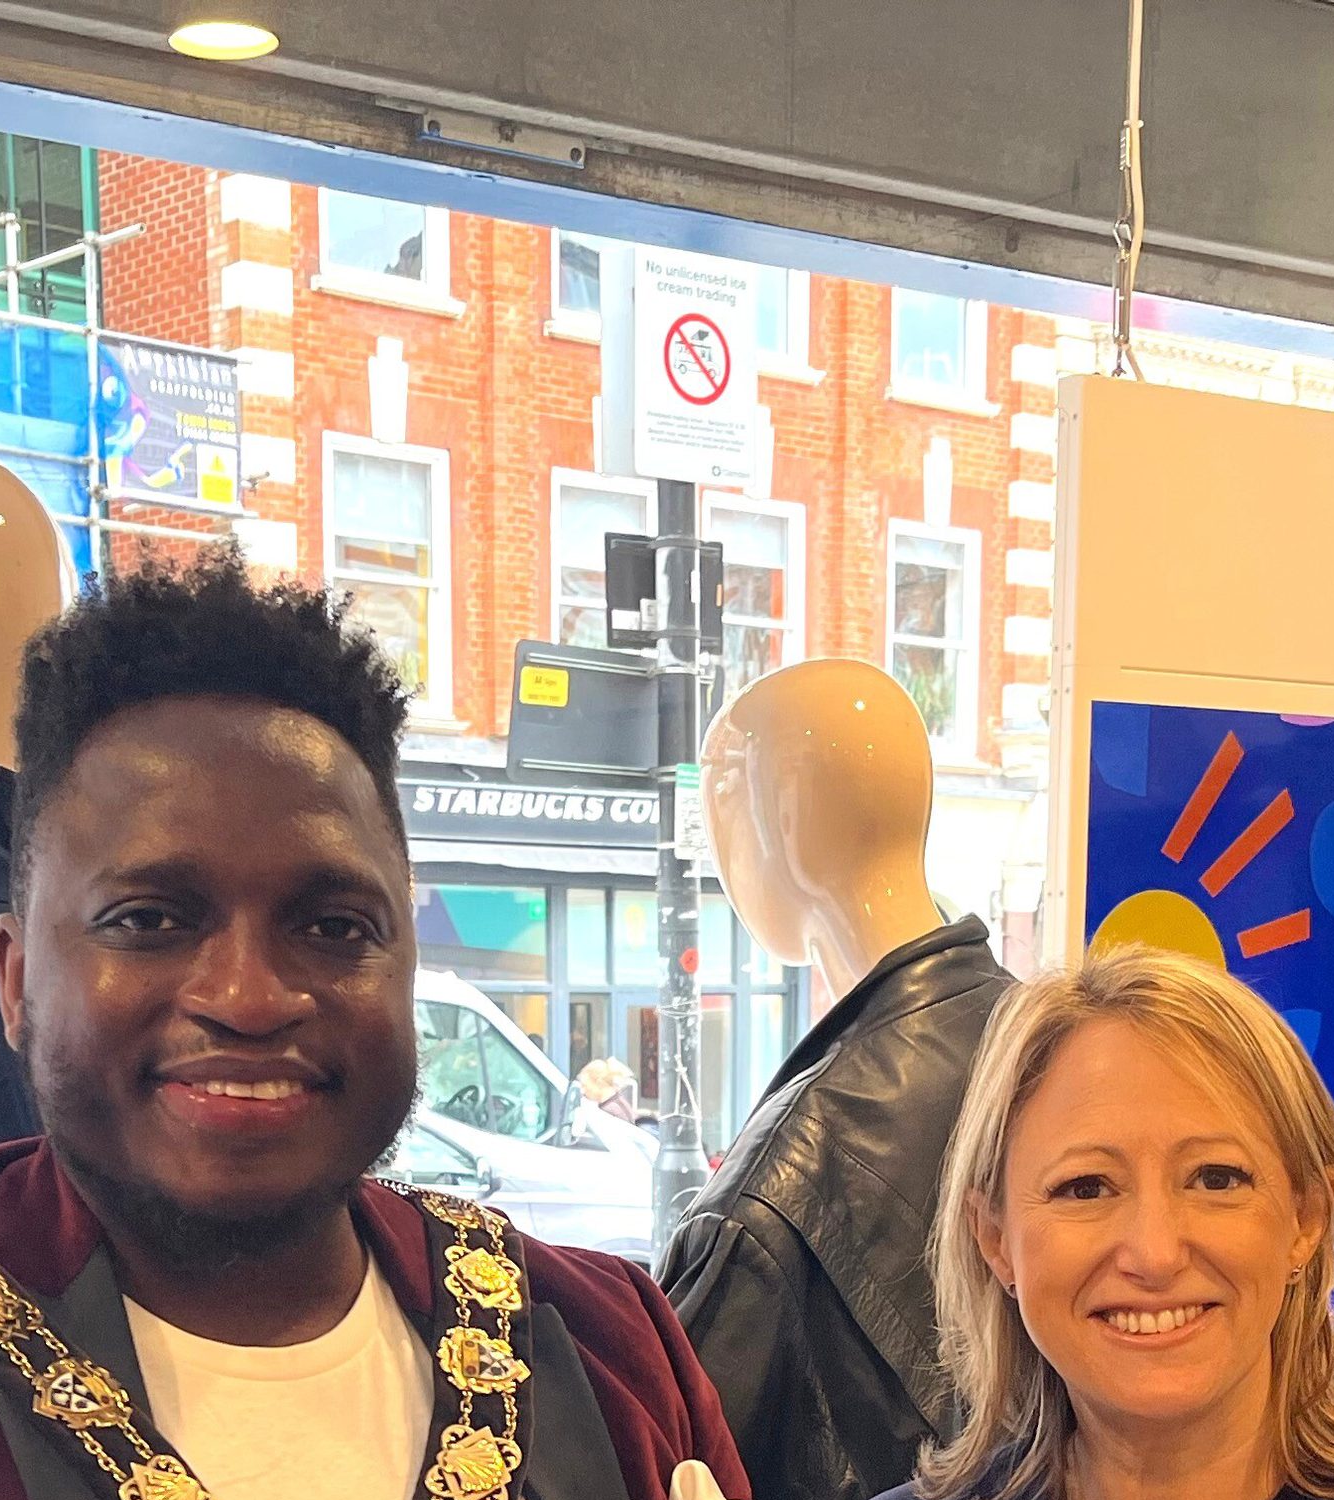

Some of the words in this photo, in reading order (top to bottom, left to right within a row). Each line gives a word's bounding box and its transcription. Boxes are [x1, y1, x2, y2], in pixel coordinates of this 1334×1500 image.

[646, 259, 662, 274] No
[666, 266, 727, 287] unlicensed
[730, 276, 747, 291] ice
[657, 281, 693, 297] cream
[696, 286, 736, 307] trading
[412, 786, 604, 822] STARBUCKS
